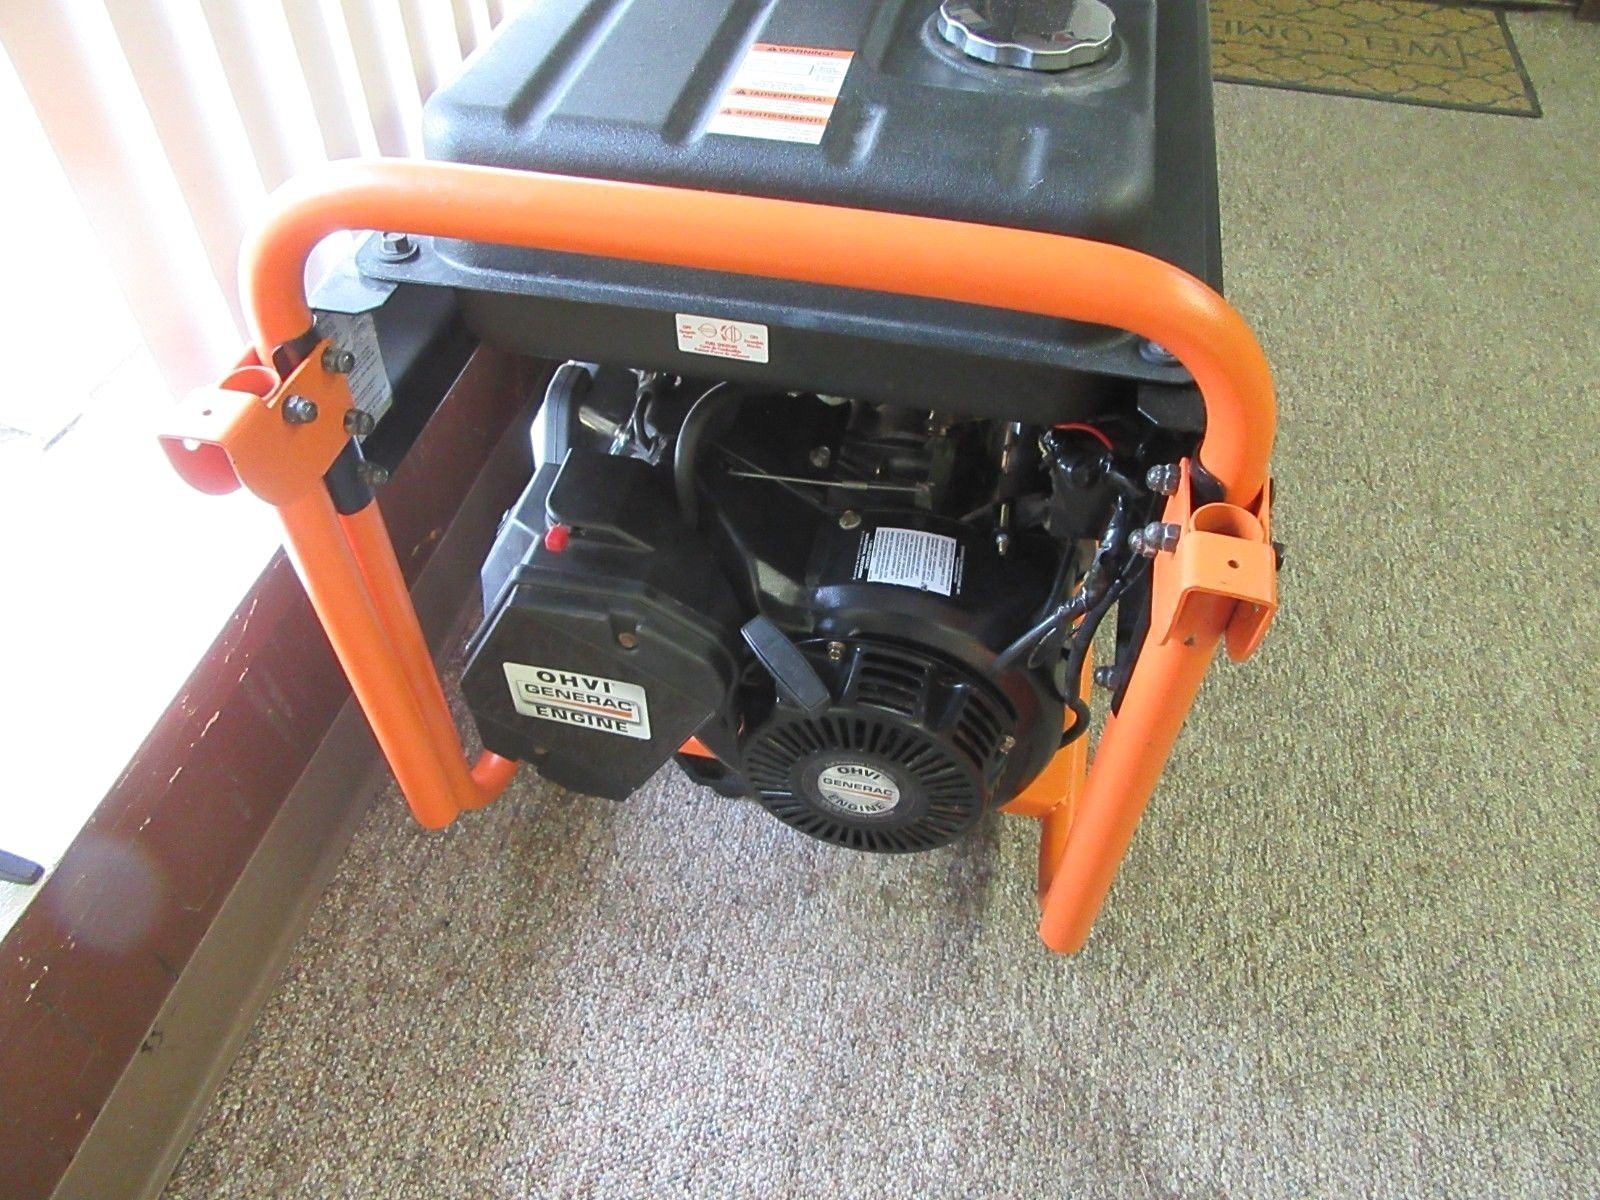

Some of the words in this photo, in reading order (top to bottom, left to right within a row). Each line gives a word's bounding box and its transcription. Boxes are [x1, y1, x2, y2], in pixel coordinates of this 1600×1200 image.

[536, 670, 611, 694] OHVI
[524, 683, 632, 712] GENERAC
[535, 705, 629, 733] ENGINE
[837, 766, 881, 780] OHVI
[823, 777, 893, 796] GENERAC
[828, 794, 886, 812] ENGINE
